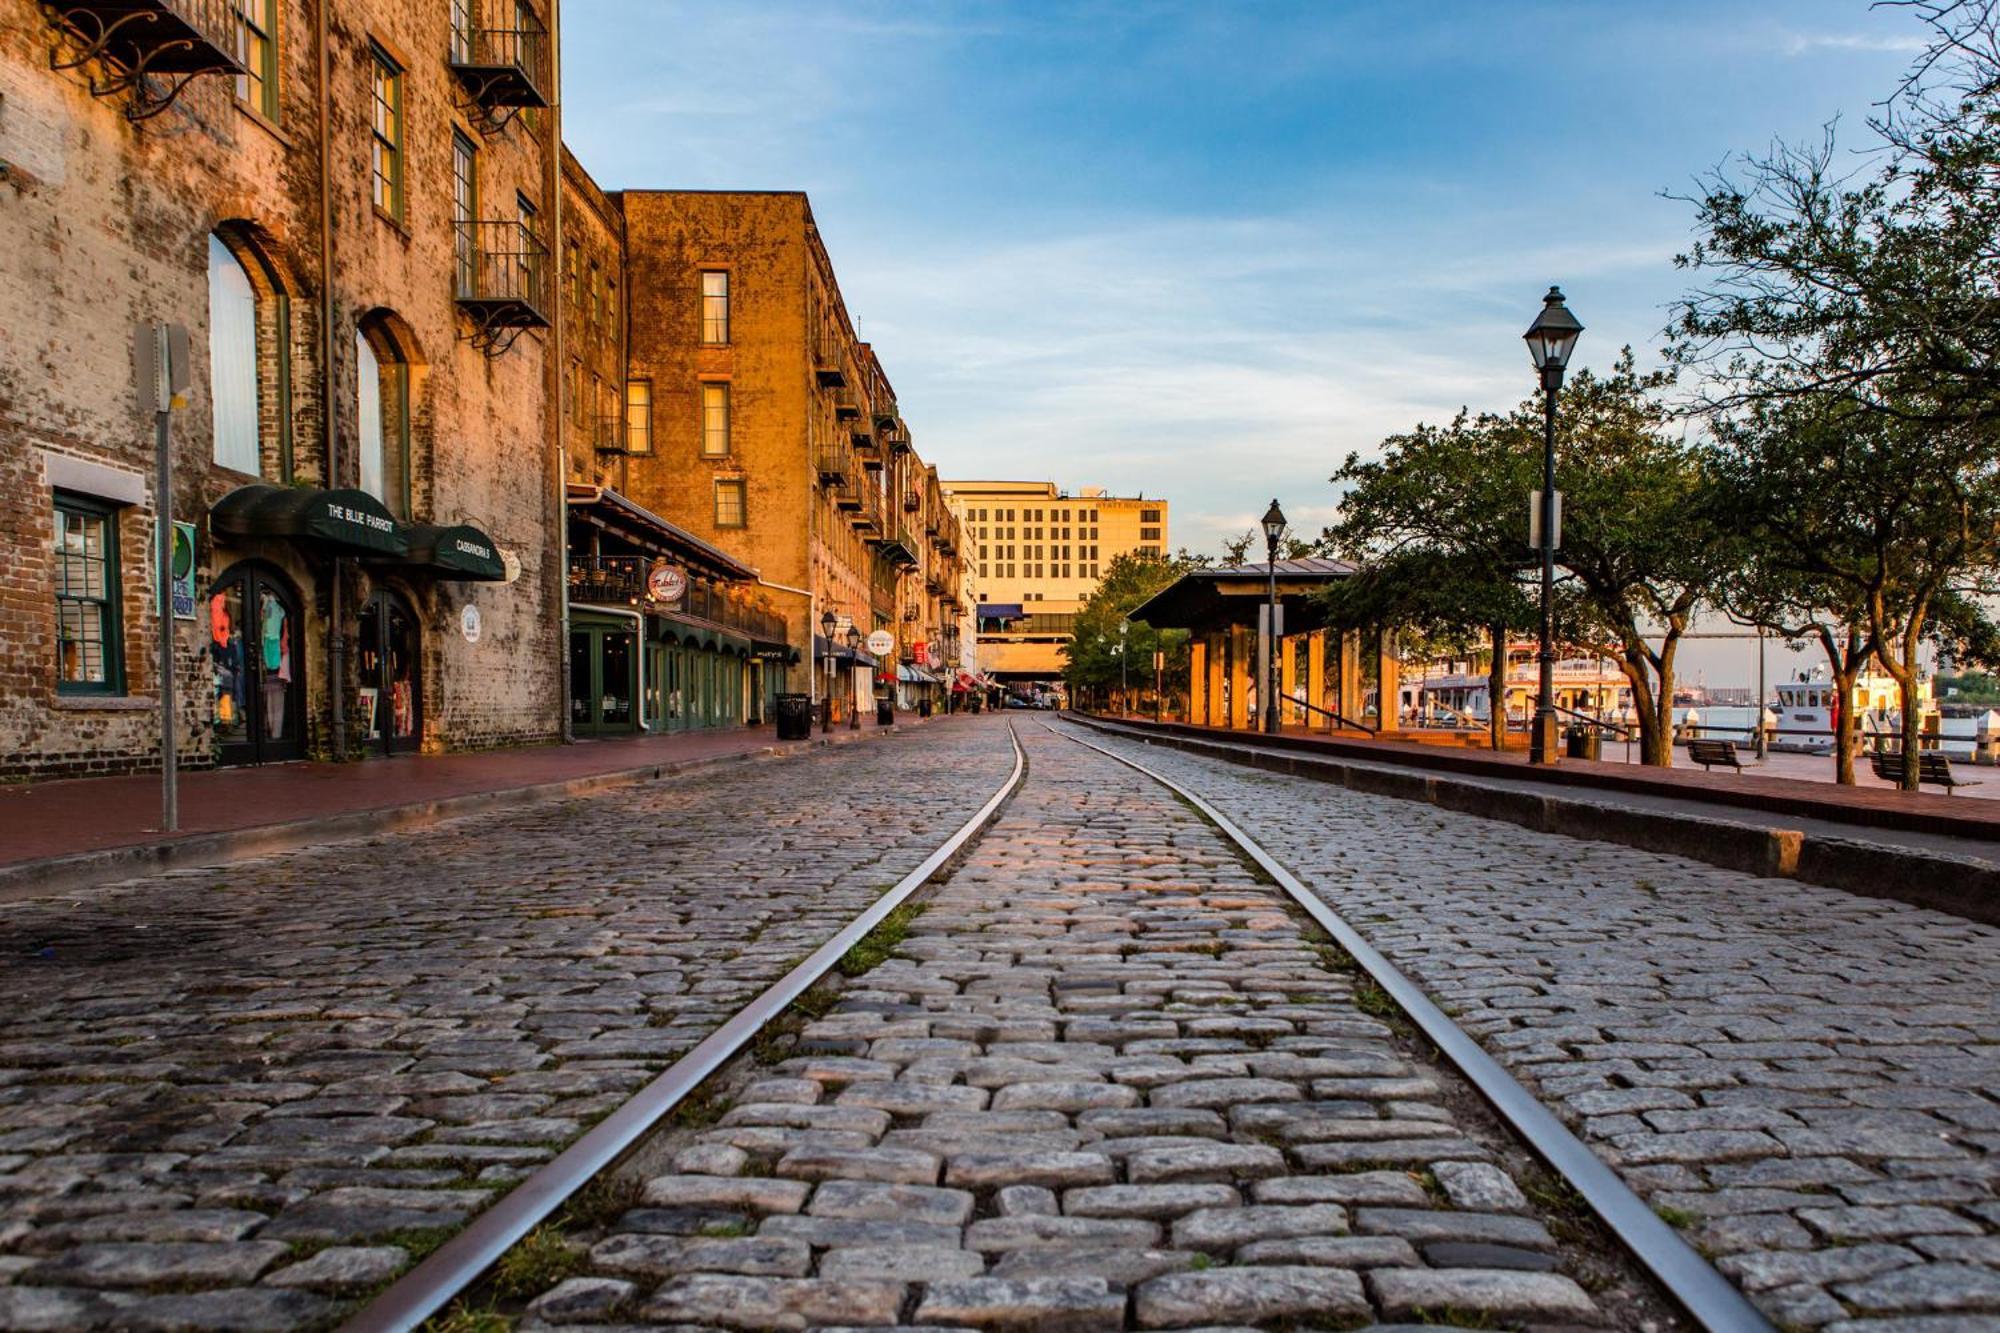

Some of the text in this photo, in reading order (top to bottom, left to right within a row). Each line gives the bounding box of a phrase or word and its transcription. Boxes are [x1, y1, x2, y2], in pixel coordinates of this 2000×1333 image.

[328, 503, 394, 533] THE BLUE PARROT
